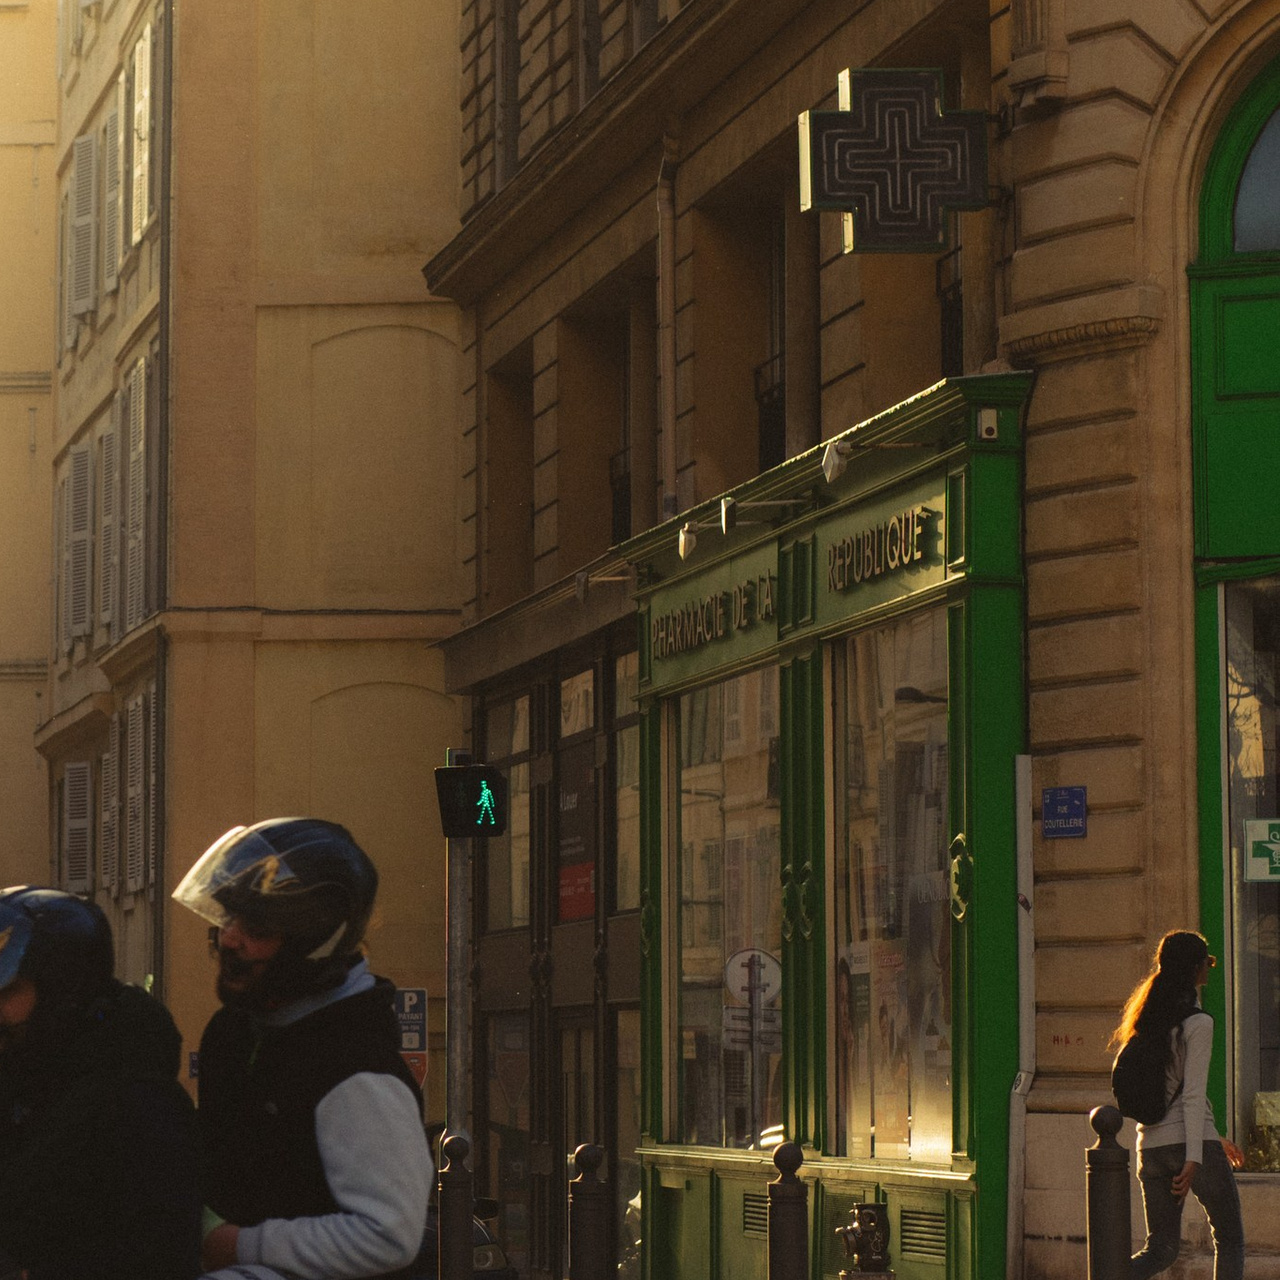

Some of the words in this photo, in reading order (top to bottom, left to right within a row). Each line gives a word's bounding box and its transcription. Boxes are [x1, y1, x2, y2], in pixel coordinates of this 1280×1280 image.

[652, 589, 724, 661] PHARMACIE
[732, 579, 748, 630] DE
[757, 569, 773, 620] LA
[828, 506, 924, 594] REPUBLIQUE
[1057, 805, 1068, 814] RUE
[1044, 818, 1083, 829] COUTELLERIE
[404, 992, 418, 1013] P
